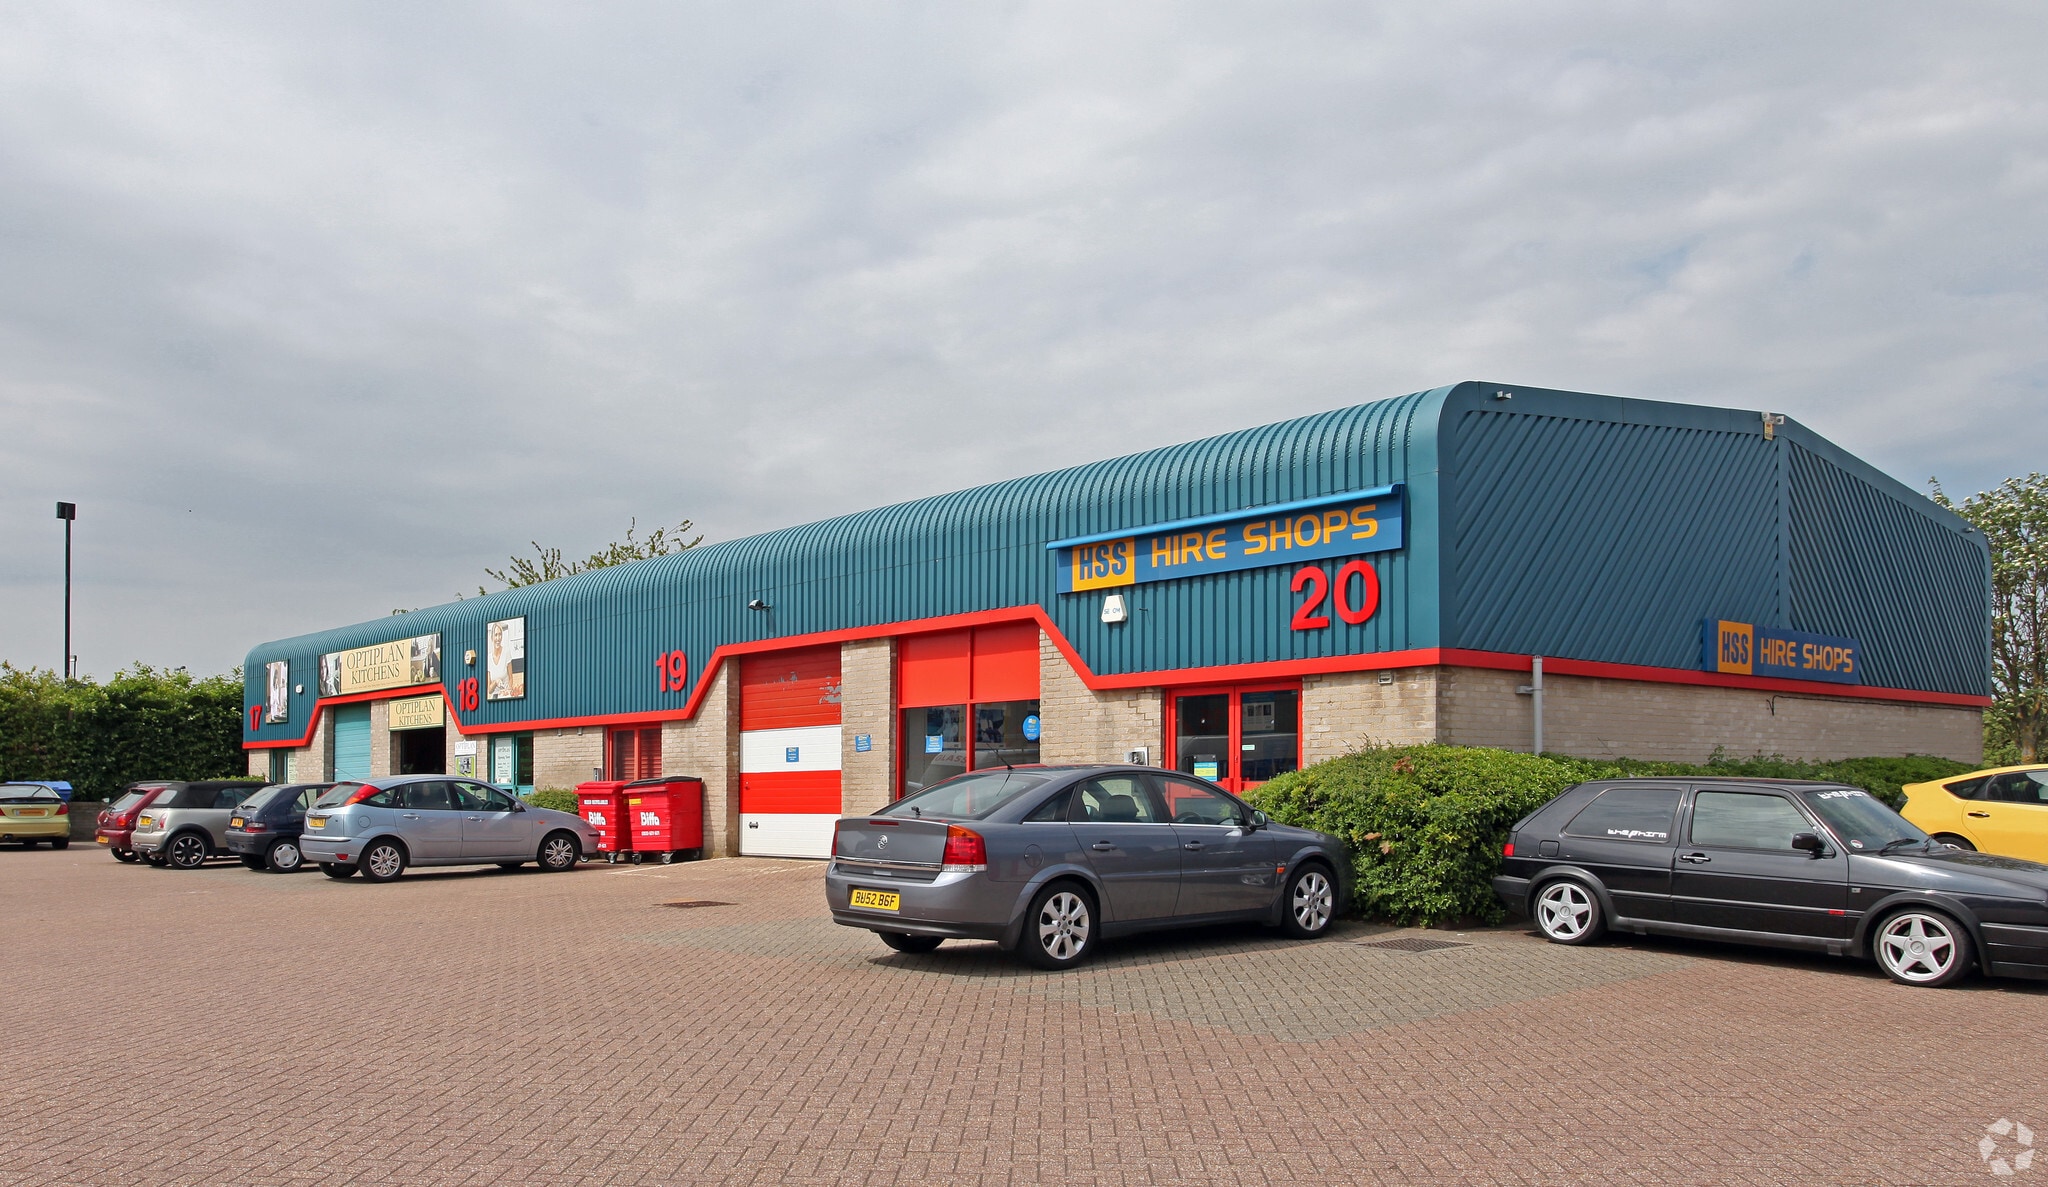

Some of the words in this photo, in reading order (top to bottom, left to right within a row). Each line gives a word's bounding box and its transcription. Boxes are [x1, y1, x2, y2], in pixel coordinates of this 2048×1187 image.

[1080, 542, 1127, 580] HSS
[1150, 528, 1227, 568] HIRE
[1242, 503, 1378, 555] SHOPS
[1290, 560, 1379, 631] 20
[346, 642, 405, 670] OPTIPLAN
[1722, 631, 1749, 665] HSS
[1760, 637, 1797, 667] HIRE
[1802, 643, 1854, 673] SHOPS
[351, 663, 400, 685] KITCHENS
[656, 649, 687, 692] 19
[395, 699, 435, 715] OPTIPLAN
[457, 677, 479, 712] 18
[249, 704, 263, 731] 17
[399, 714, 432, 726] KITCHENS
[588, 811, 607, 826] Biffa
[640, 811, 661, 826] Biffa
[855, 891, 877, 905] BU52
